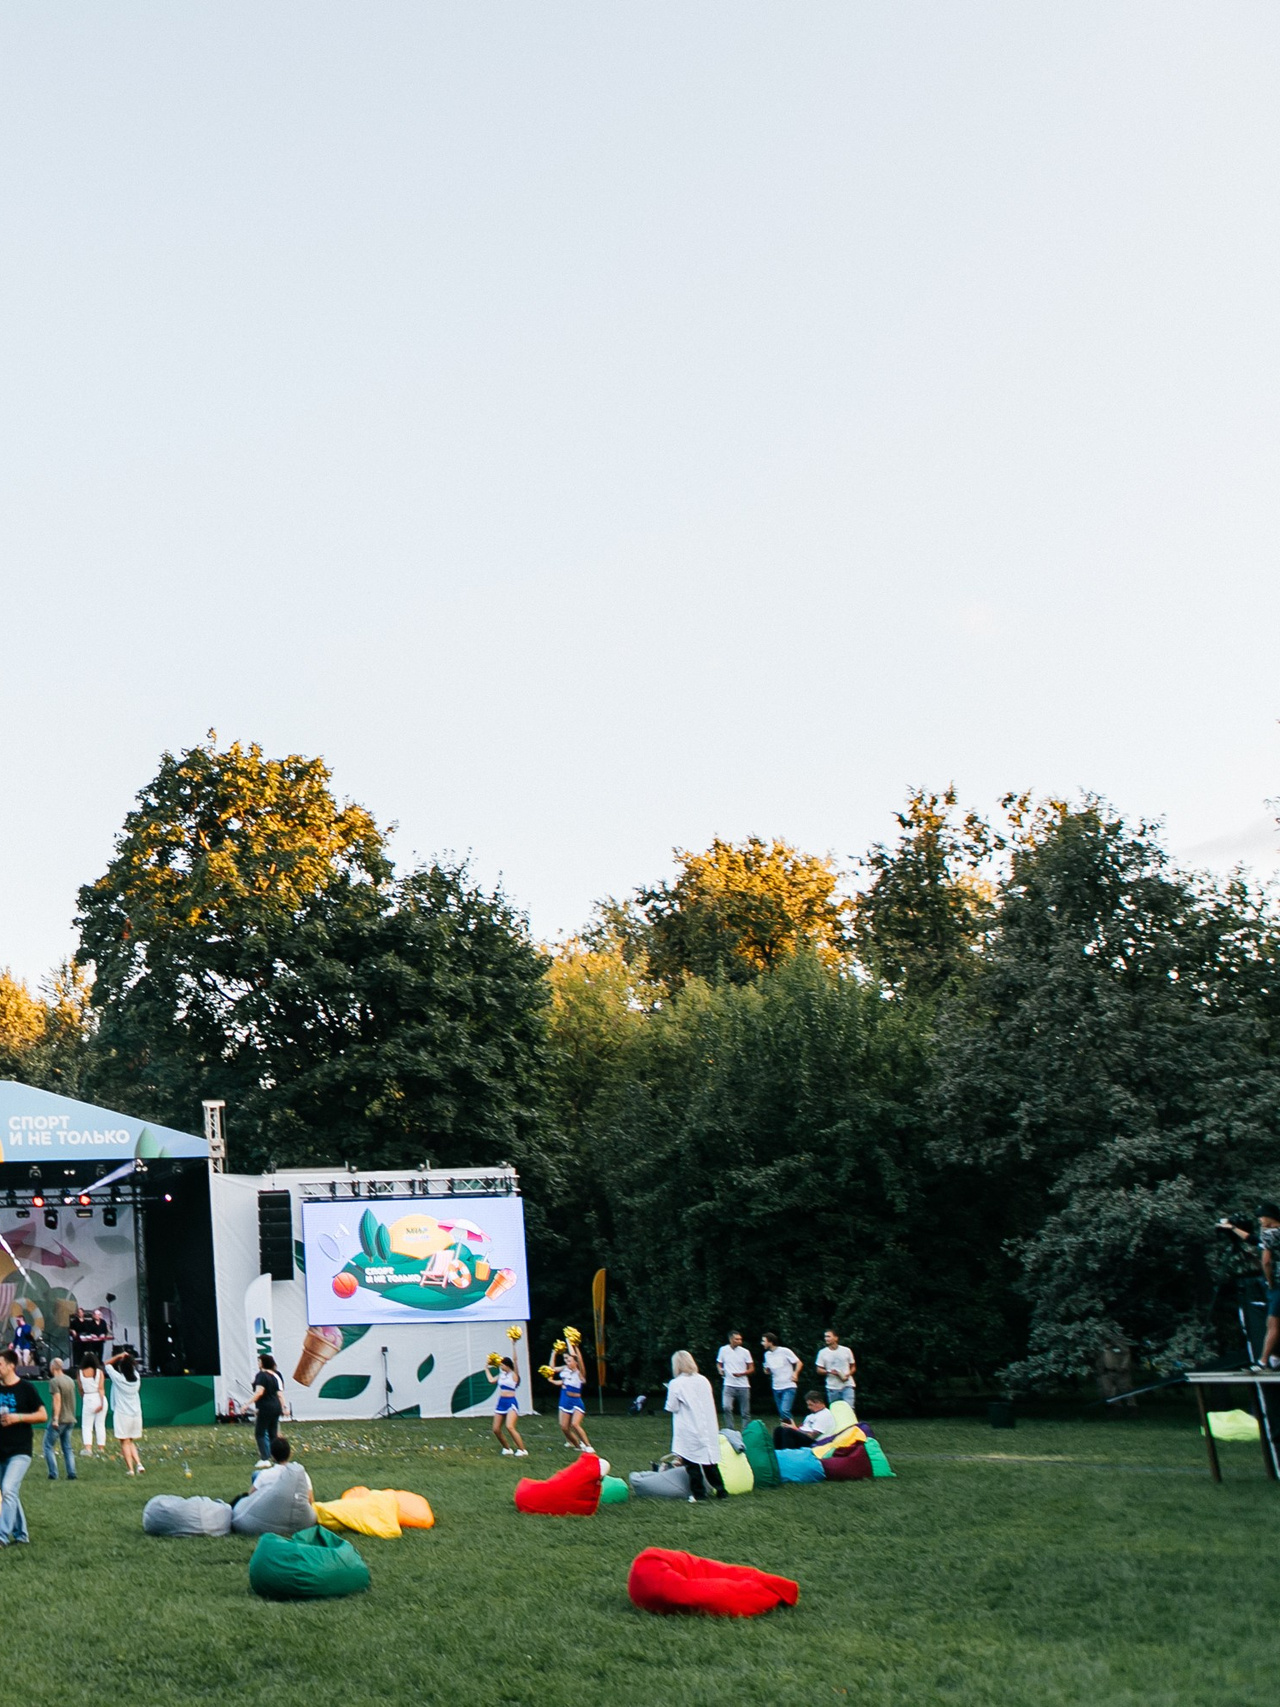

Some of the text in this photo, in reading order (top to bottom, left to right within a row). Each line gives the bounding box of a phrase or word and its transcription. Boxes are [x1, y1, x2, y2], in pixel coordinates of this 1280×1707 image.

[8, 1115, 70, 1130] СПОРТ
[9, 1129, 130, 1145] И НЕ ТОЛЬКО
[254, 1317, 272, 1355] ИР
